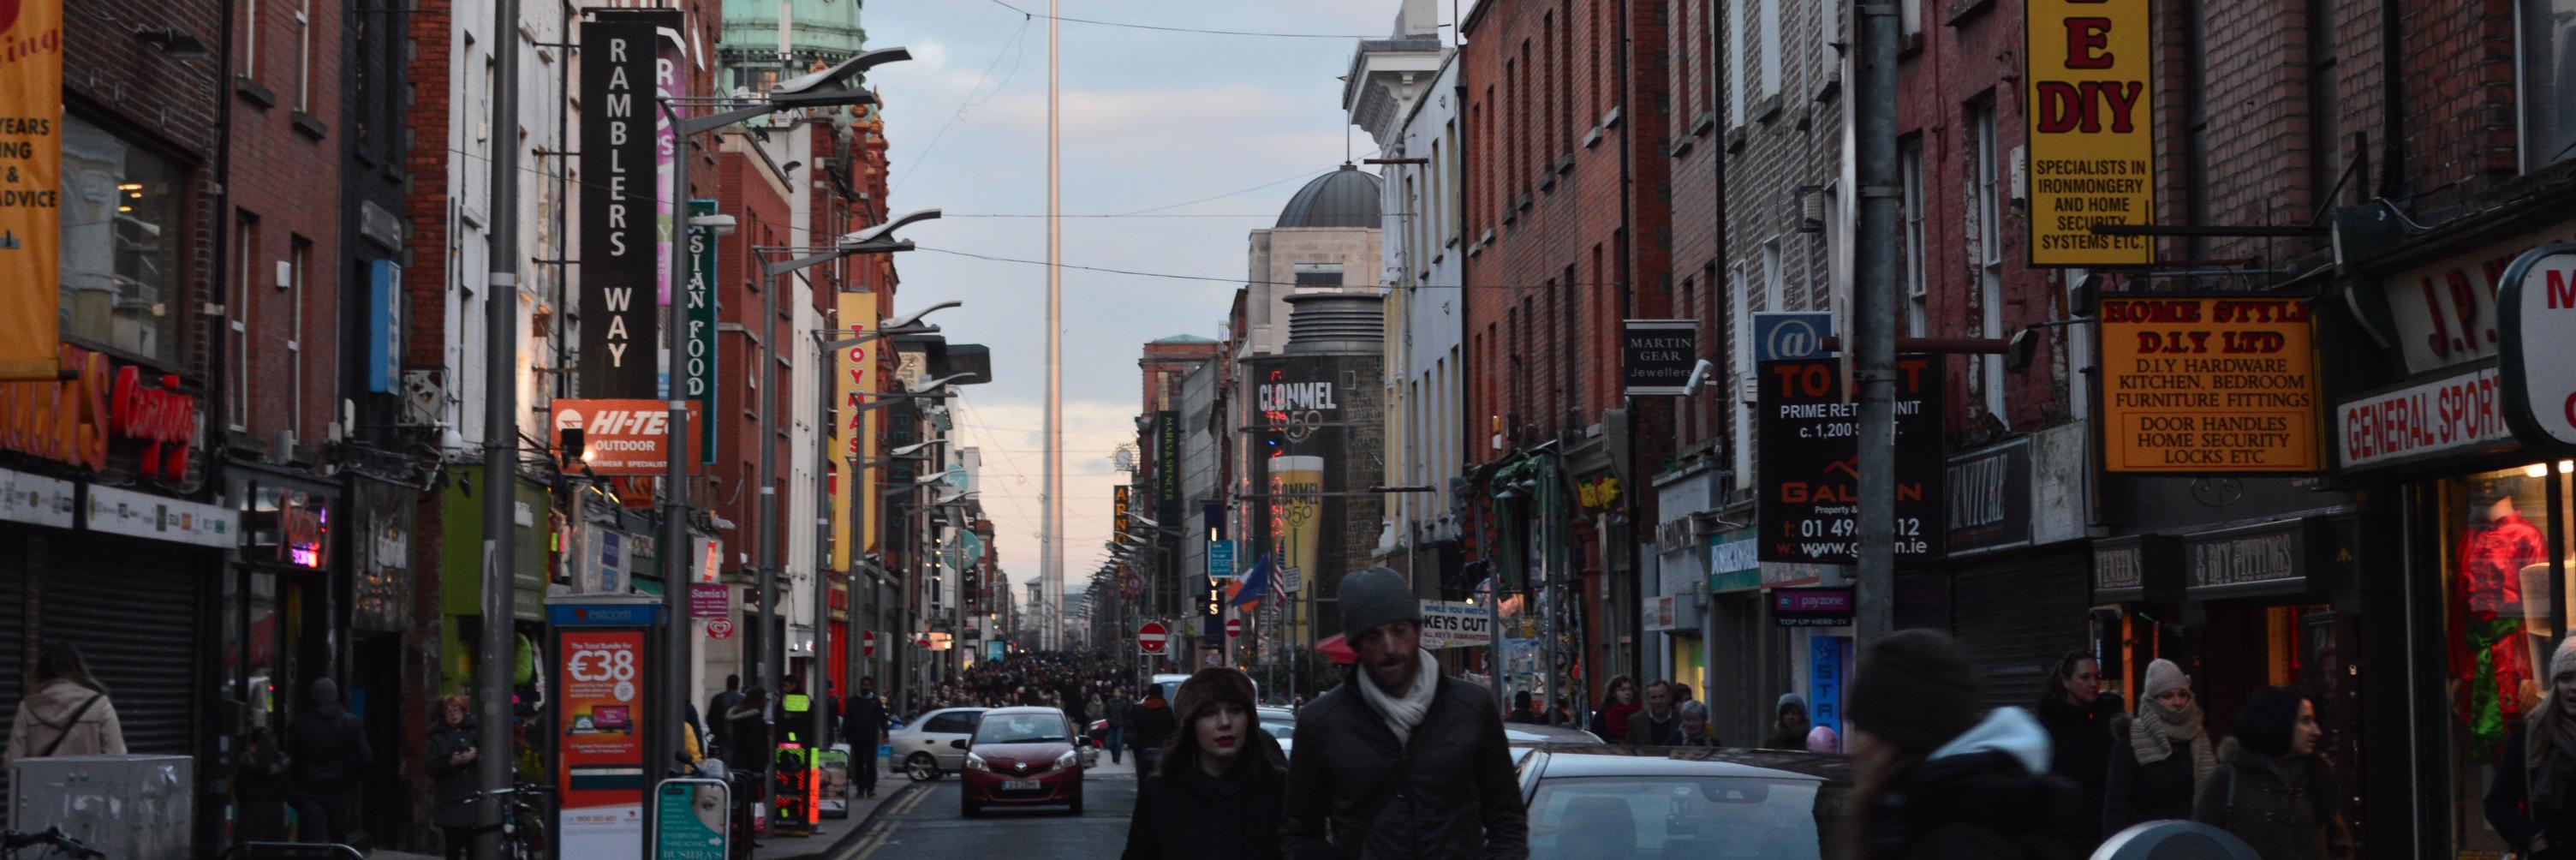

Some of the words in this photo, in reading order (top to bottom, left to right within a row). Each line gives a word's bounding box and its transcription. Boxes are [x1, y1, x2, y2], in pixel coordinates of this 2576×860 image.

[2063, 0, 2114, 69] E
[6, 28, 59, 63] ing
[2036, 81, 2144, 134] DIY
[606, 39, 631, 256] RAMBLERS
[7, 166, 19, 182] &
[2036, 160, 2126, 175] SPECIALISTS
[2132, 160, 2146, 175] IN
[2038, 178, 2144, 194] IRONMONGERY
[2054, 197, 2084, 212] AND
[2088, 197, 2130, 212] HOME
[2057, 216, 2127, 231] SECURITY
[2042, 235, 2108, 249] SYSTEMS
[2114, 235, 2144, 249] ETC.
[687, 212, 706, 309] ASIAN
[2103, 302, 2202, 323] HOME
[2213, 302, 2312, 323] STYLE
[604, 288, 632, 367] WAY
[1631, 337, 1691, 349] MARTIN
[2138, 331, 2211, 354] D.I.Y
[2221, 331, 2285, 354] LTD
[687, 320, 705, 396] FOOD
[1640, 351, 1681, 361] GEAR
[1631, 367, 1692, 377] Jewellers
[2136, 359, 2178, 373] D.I.Y
[2185, 359, 2287, 373] HARDWARE
[1774, 364, 1831, 397] TO
[2213, 375, 2305, 389] BEDROOM
[1260, 382, 1337, 411] CLONMEL
[2116, 393, 2220, 407] FURNITURE
[2227, 393, 2310, 407] FITTINGS
[1780, 404, 1827, 419] PRIME
[1830, 403, 1859, 417] RET
[587, 410, 689, 435] HI-TE
[2141, 417, 2194, 431] DOOR
[2202, 417, 2287, 431] HANDLES
[2347, 393, 2434, 461] GENERAL
[1165, 416, 1173, 450] MARKS
[1816, 423, 1852, 439] 1,200
[596, 440, 655, 451] OUTDOOR
[2137, 433, 2193, 447] HOME
[2202, 433, 2290, 447] SECURITY
[2165, 450, 2223, 463] LOCKS
[2231, 450, 2265, 463] ETC
[1165, 459, 1173, 501] SPENCER
[1781, 482, 1922, 504] GALN
[1947, 453, 2007, 529] RNITURE
[1815, 506, 1849, 515] Property
[1783, 521, 1795, 538] t:
[1801, 519, 1822, 538] 01
[1893, 518, 1920, 536] 12
[1777, 542, 1795, 555] w:
[1802, 596, 1844, 607] payzone
[588, 610, 632, 620] eircom
[1424, 615, 1458, 630] KEYS
[1463, 618, 1488, 631] CUT
[566, 649, 635, 682] €38
[1817, 664, 1833, 728] STA
